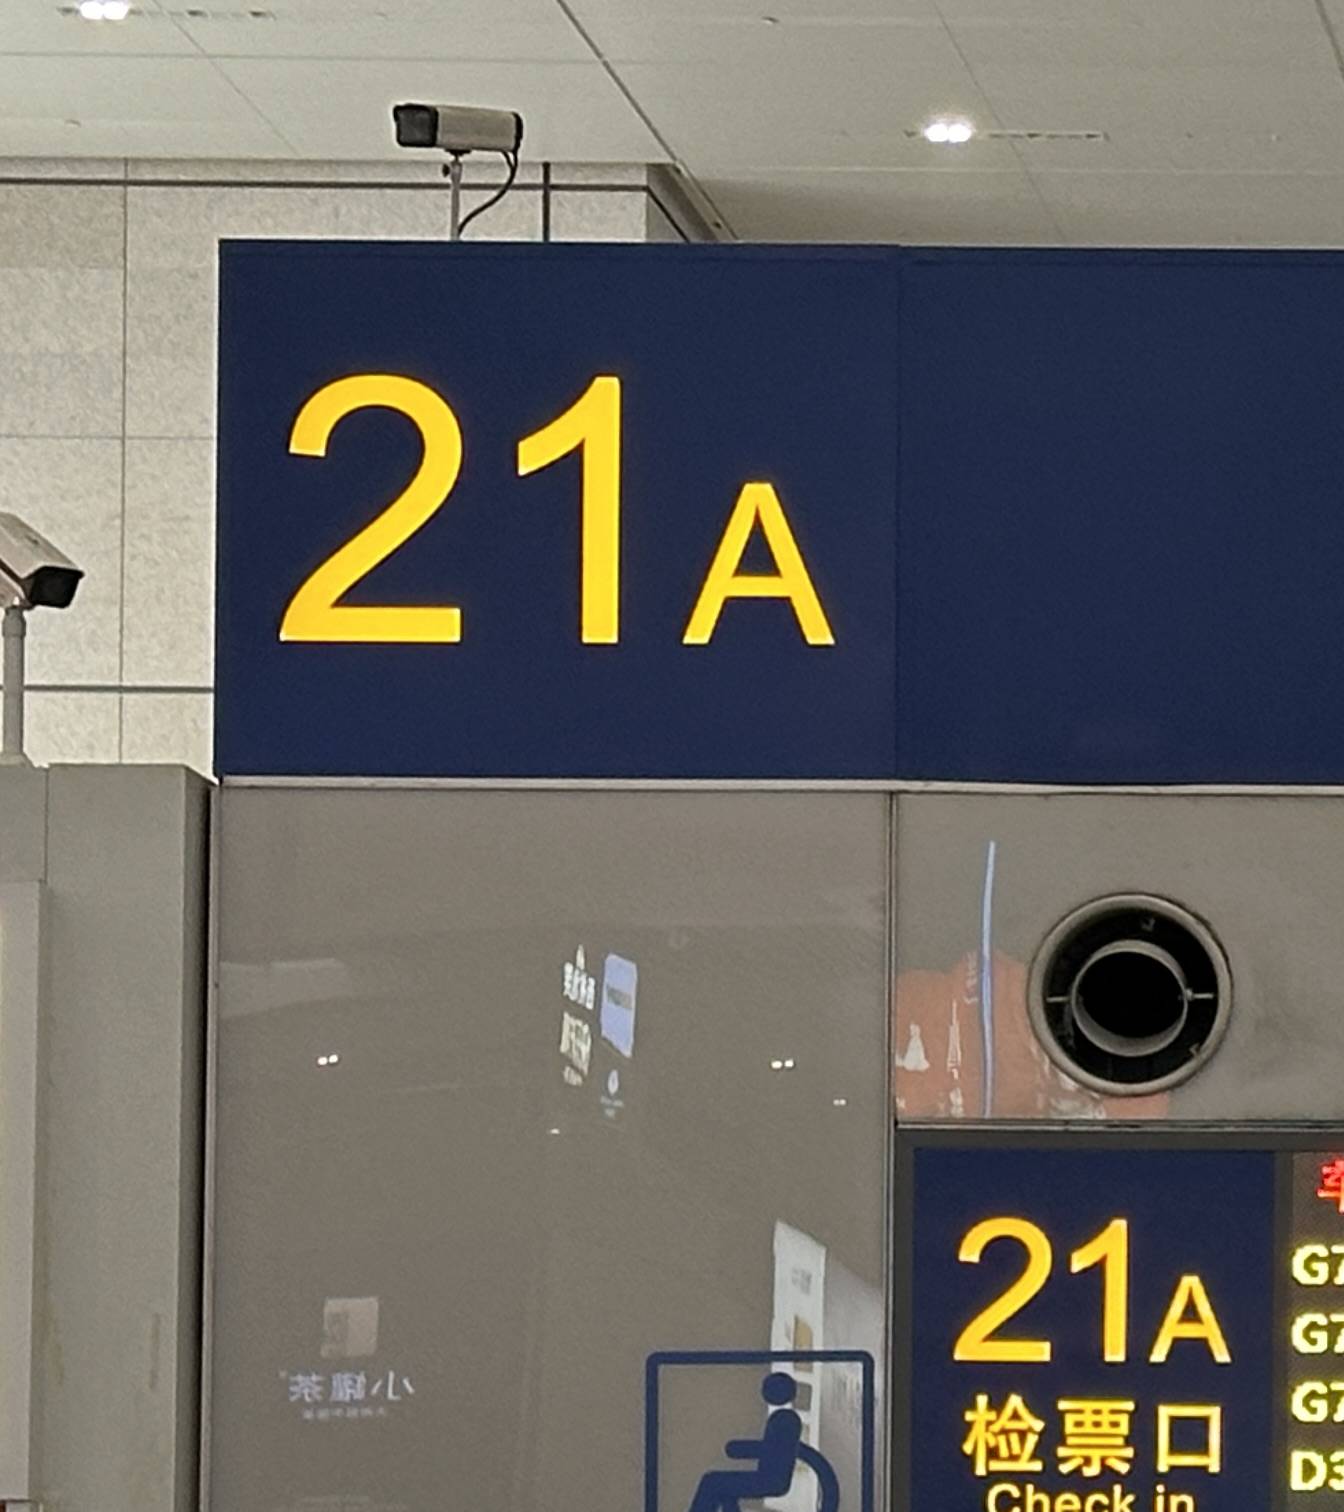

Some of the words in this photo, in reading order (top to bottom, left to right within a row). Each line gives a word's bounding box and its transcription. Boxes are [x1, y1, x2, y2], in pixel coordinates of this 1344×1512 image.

[280, 375, 835, 646] 21A
[954, 1218, 1231, 1364] 21A
[963, 1394, 1223, 1478] 检票口
